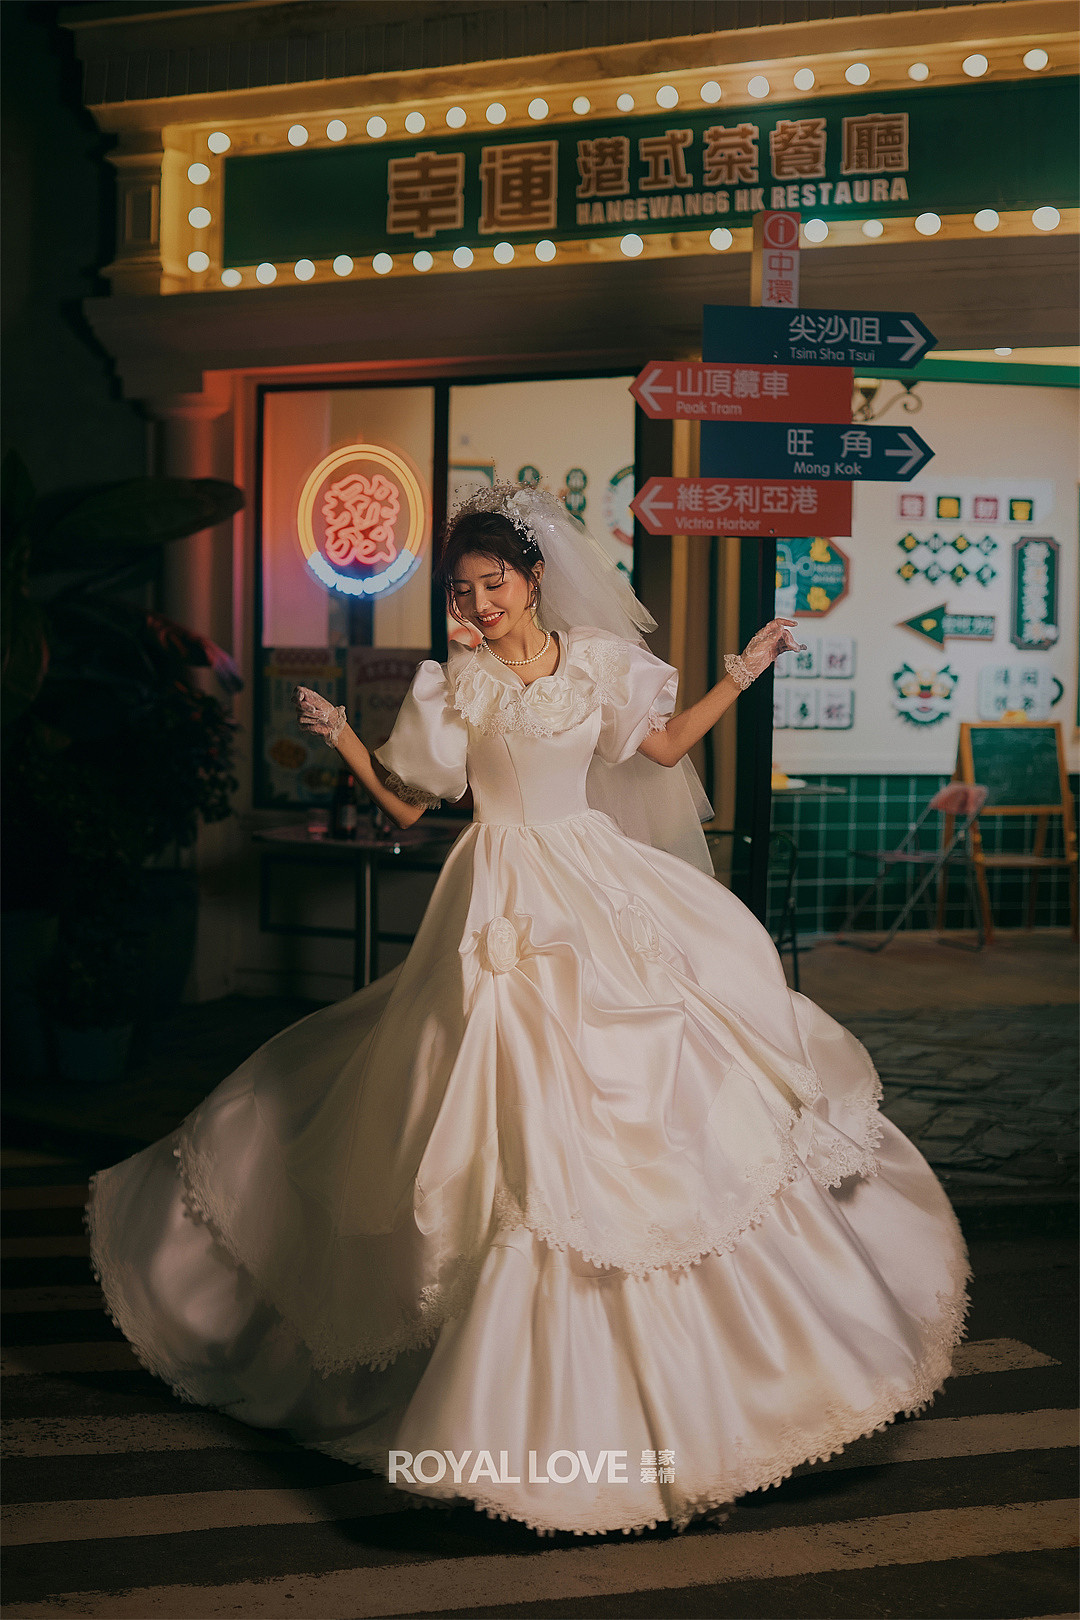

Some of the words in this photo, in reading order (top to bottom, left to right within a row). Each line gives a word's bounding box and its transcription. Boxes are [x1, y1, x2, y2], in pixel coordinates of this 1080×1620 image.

[575, 111, 910, 198] 港式茶餐廳
[386, 139, 559, 239] 幸運
[734, 187, 766, 211] HK
[770, 177, 910, 209] RESTAURA
[766, 251, 794, 304] 中環
[788, 315, 882, 345] 尖沙咀
[790, 347, 817, 360] Tsim
[819, 348, 846, 361] Sha
[849, 348, 876, 362] Tsui
[675, 368, 790, 400] 山頂纜車
[675, 400, 708, 415] Peak
[710, 400, 743, 415] Tram
[786, 428, 872, 459] 旺角
[793, 461, 830, 476] Mong
[834, 462, 863, 475] Kok
[676, 484, 818, 515] 維多利亞港
[675, 516, 714, 531] Victria
[717, 517, 761, 532] Harbor
